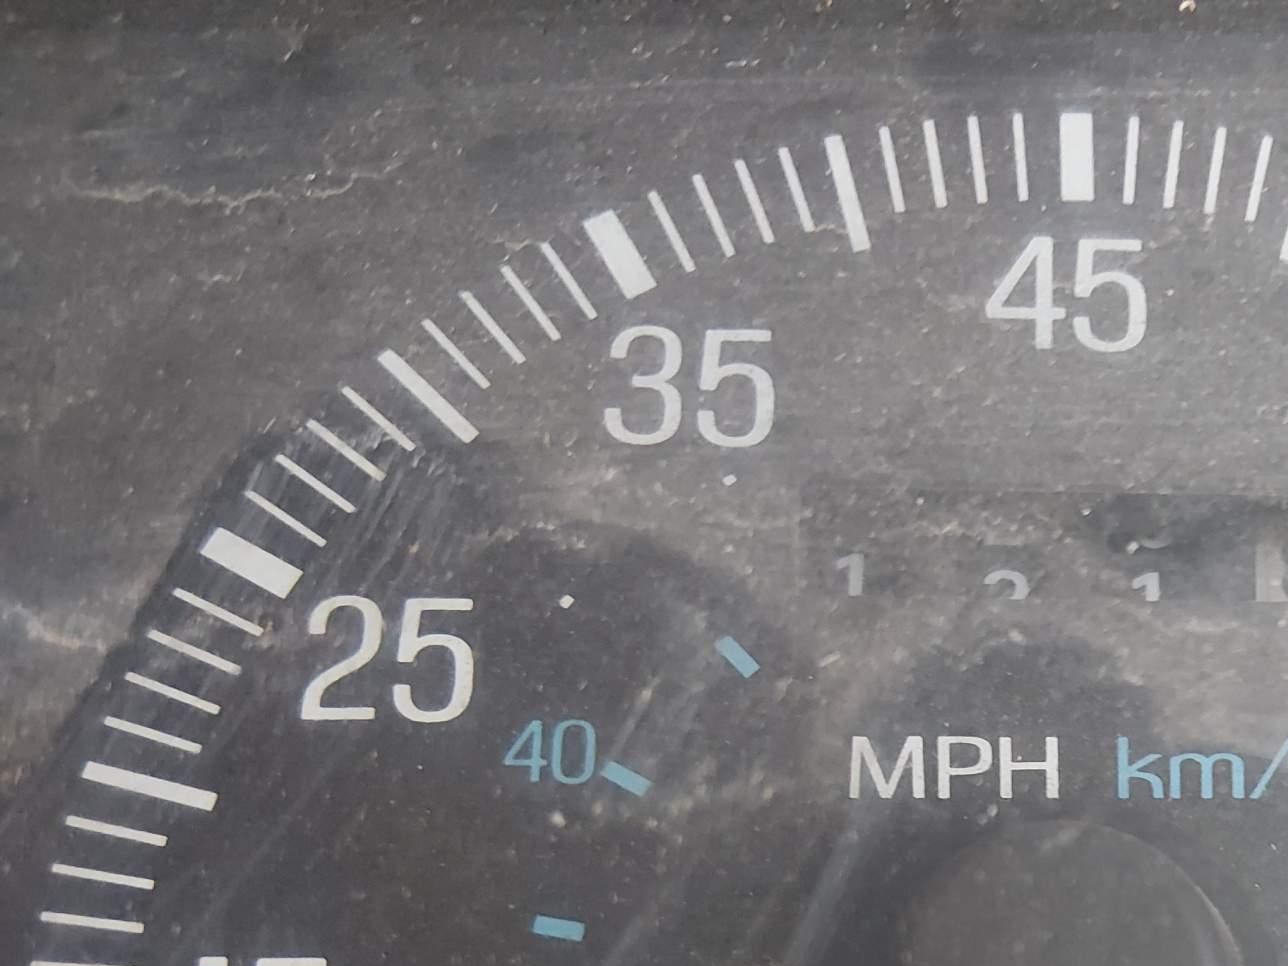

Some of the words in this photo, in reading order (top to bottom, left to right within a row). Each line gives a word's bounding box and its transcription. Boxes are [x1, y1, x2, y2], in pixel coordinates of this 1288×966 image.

[985, 235, 1147, 353] 45
[603, 325, 775, 448] 35
[300, 594, 475, 723] 25
[503, 719, 597, 785] 40
[849, 735, 1060, 800] MPH
